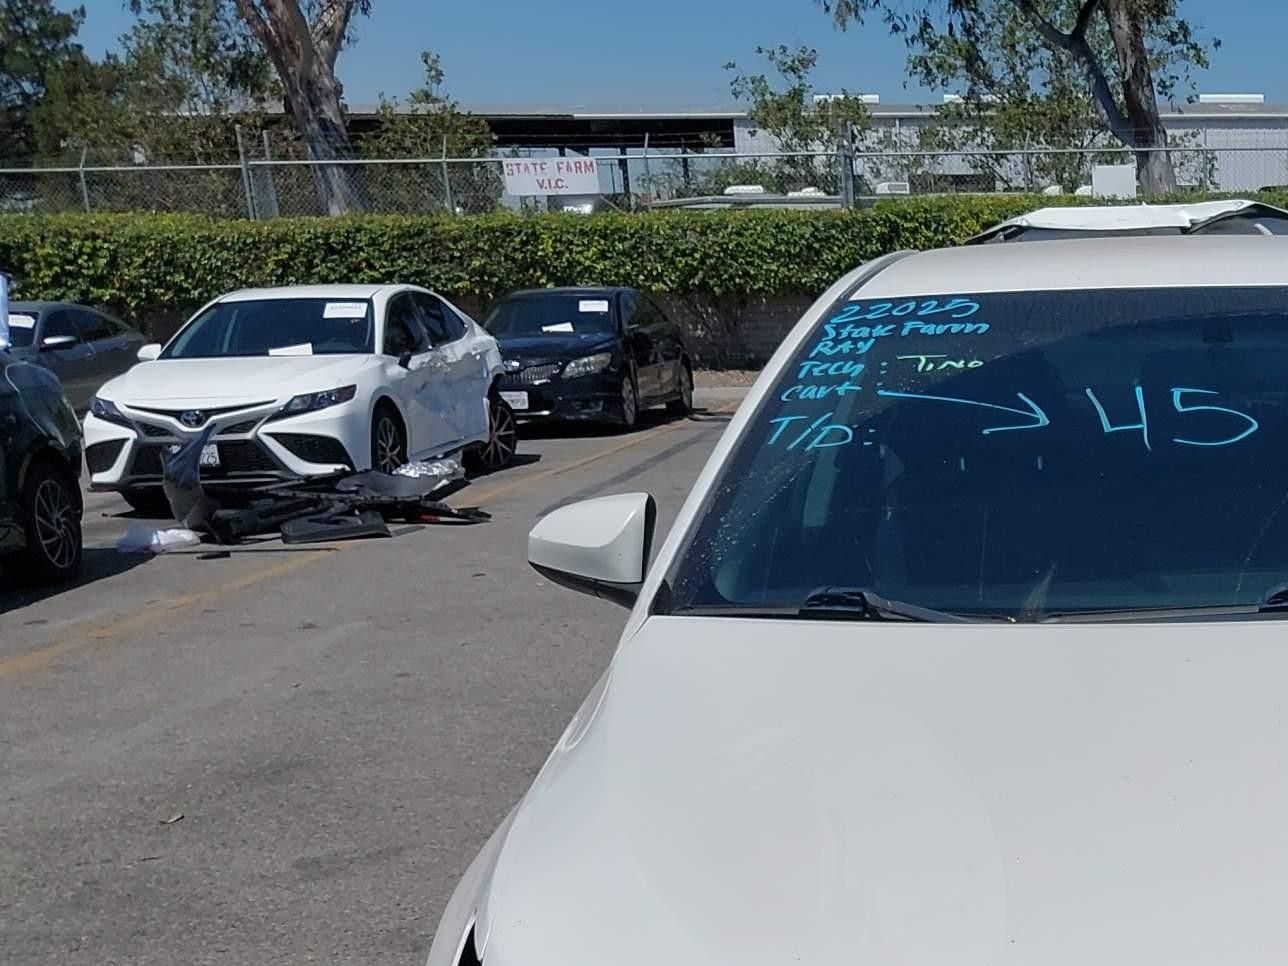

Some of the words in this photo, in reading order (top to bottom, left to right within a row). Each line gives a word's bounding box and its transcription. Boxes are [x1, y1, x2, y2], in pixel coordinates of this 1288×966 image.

[505, 162, 547, 176] STATE
[557, 160, 595, 174] FARM
[536, 178, 569, 190] V.I.C.
